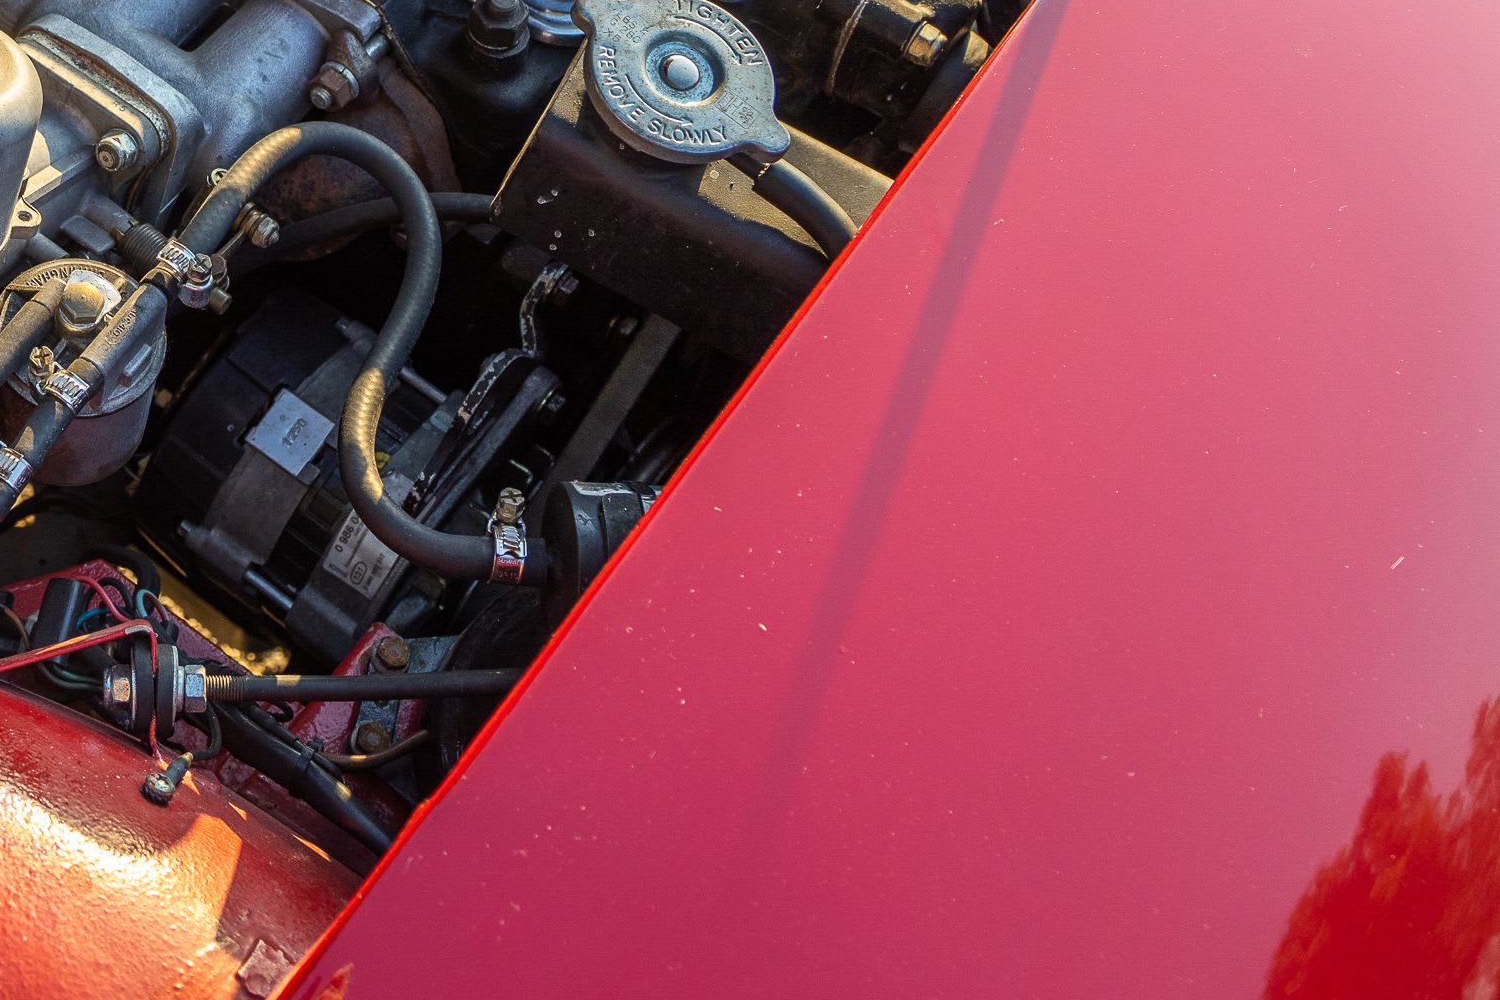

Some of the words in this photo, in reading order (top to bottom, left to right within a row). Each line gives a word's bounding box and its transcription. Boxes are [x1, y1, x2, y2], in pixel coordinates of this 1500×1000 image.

[598, 45, 645, 122] REMOVE
[647, 118, 728, 145] SLOWLY
[339, 525, 355, 545] 986
